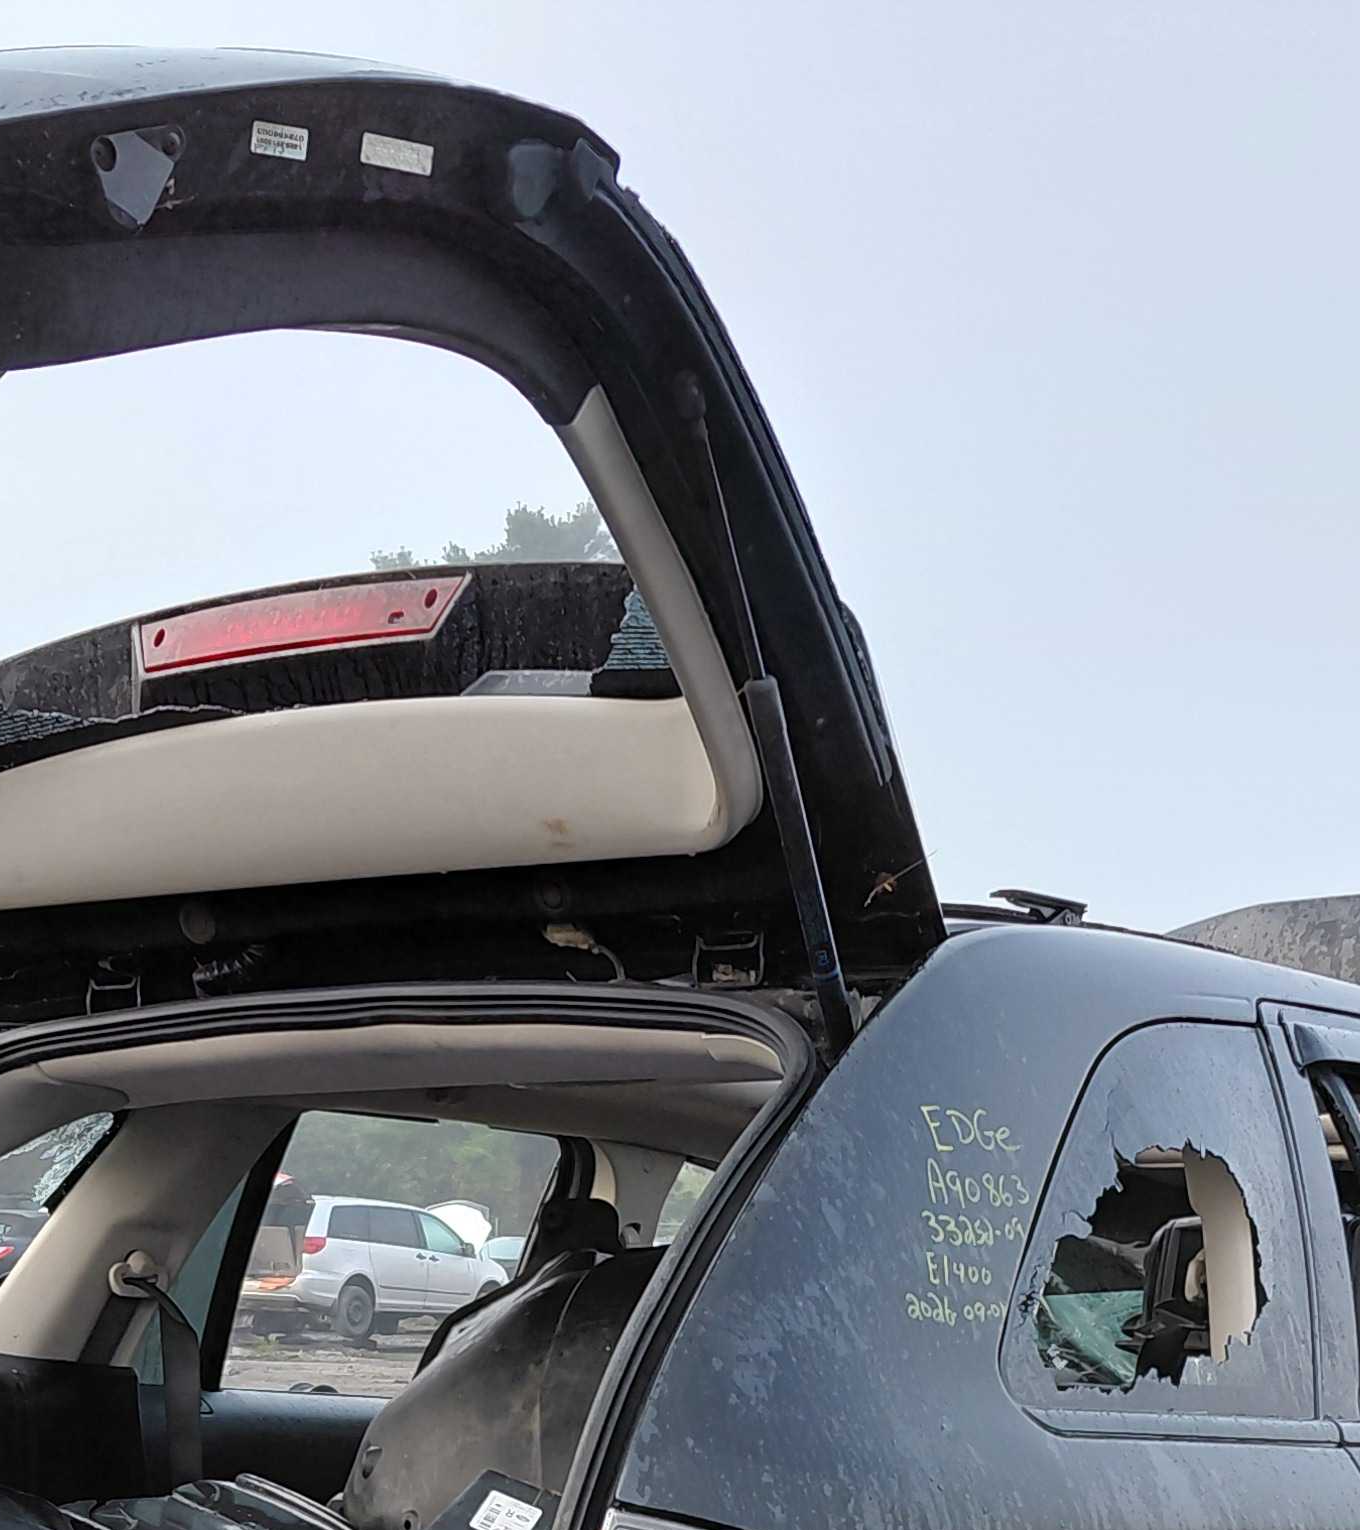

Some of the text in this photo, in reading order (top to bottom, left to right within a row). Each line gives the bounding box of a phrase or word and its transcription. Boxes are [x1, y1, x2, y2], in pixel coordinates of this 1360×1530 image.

[920, 1105, 1023, 1151] EDGe
[927, 1158, 1029, 1208] A90863
[921, 1210, 1025, 1247] 33252-09
